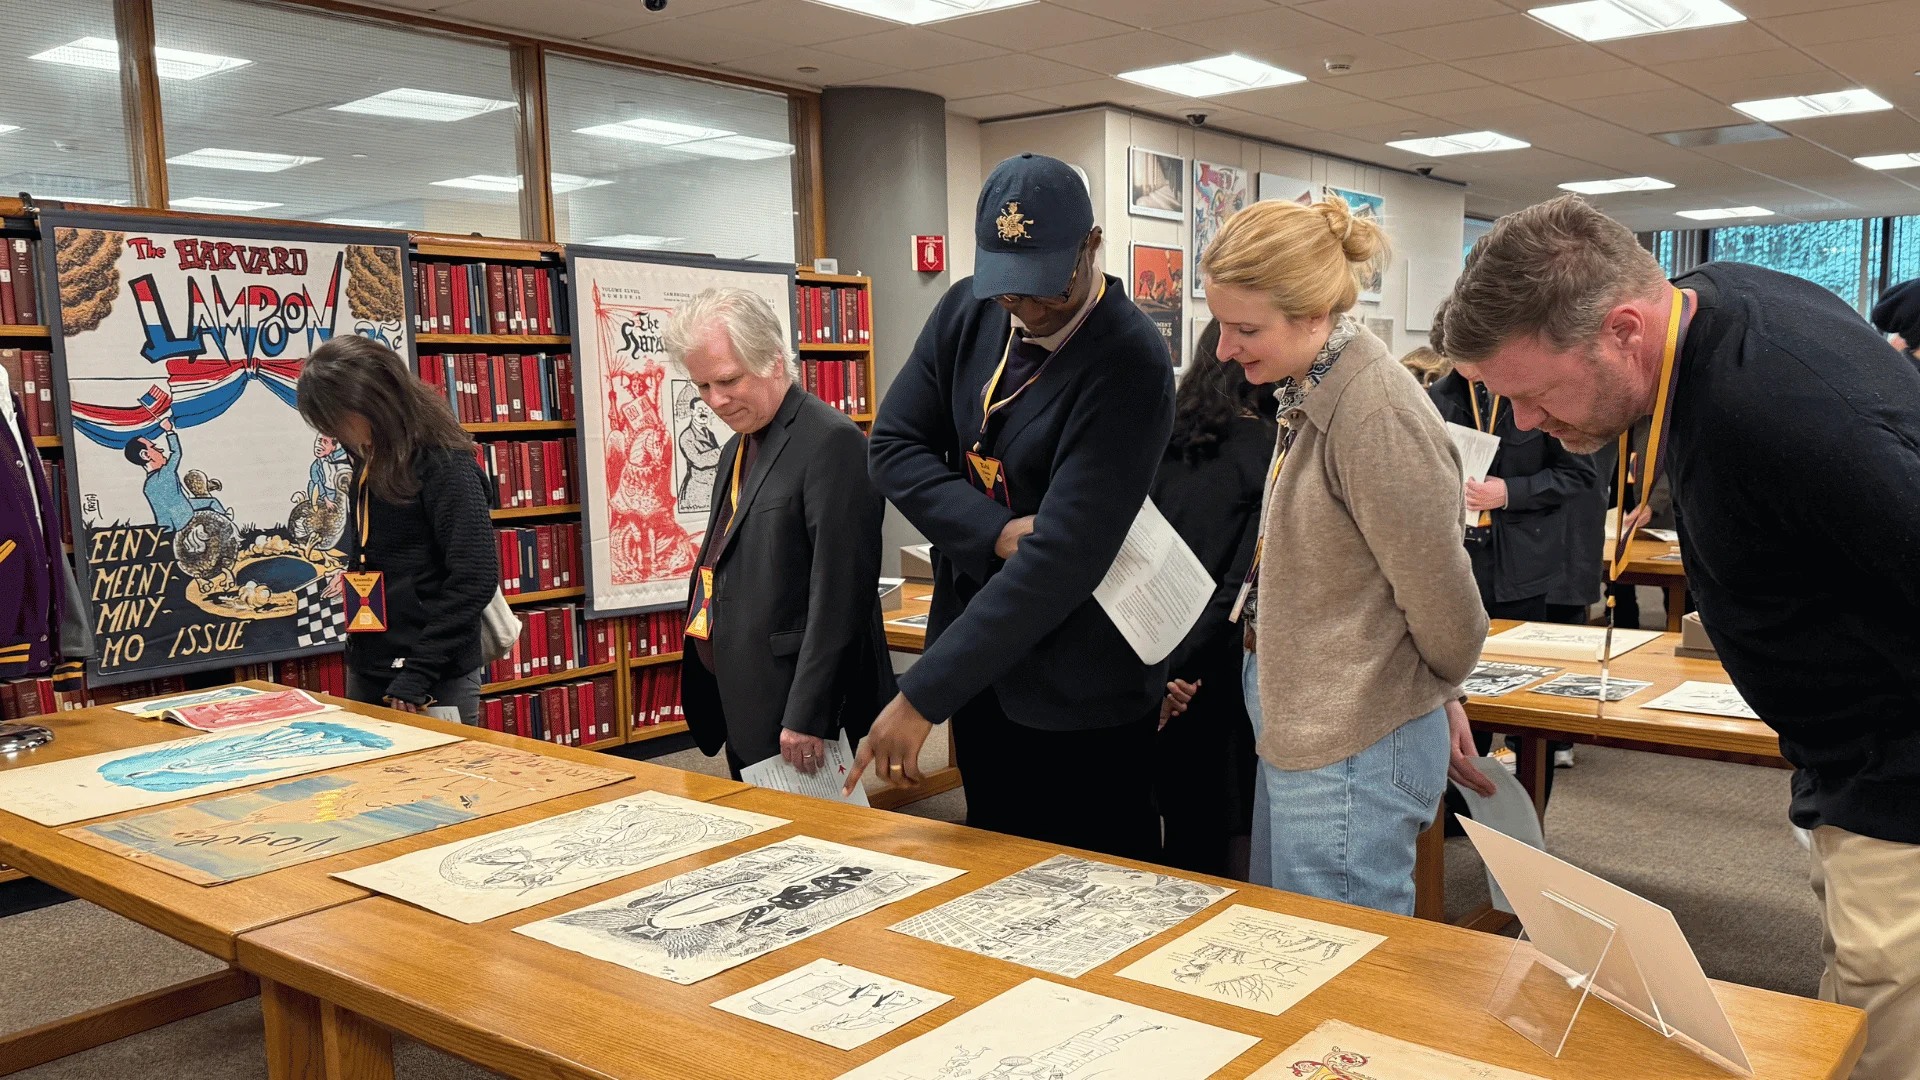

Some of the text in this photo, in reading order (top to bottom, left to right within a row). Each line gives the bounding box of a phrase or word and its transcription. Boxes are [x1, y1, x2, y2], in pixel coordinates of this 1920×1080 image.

[127, 238, 308, 276] The HARVARD
[128, 251, 344, 363] LAMPOON
[635, 312, 660, 333] The
[101, 620, 251, 668] MO ISSUE
[174, 831, 341, 857] Vogue
